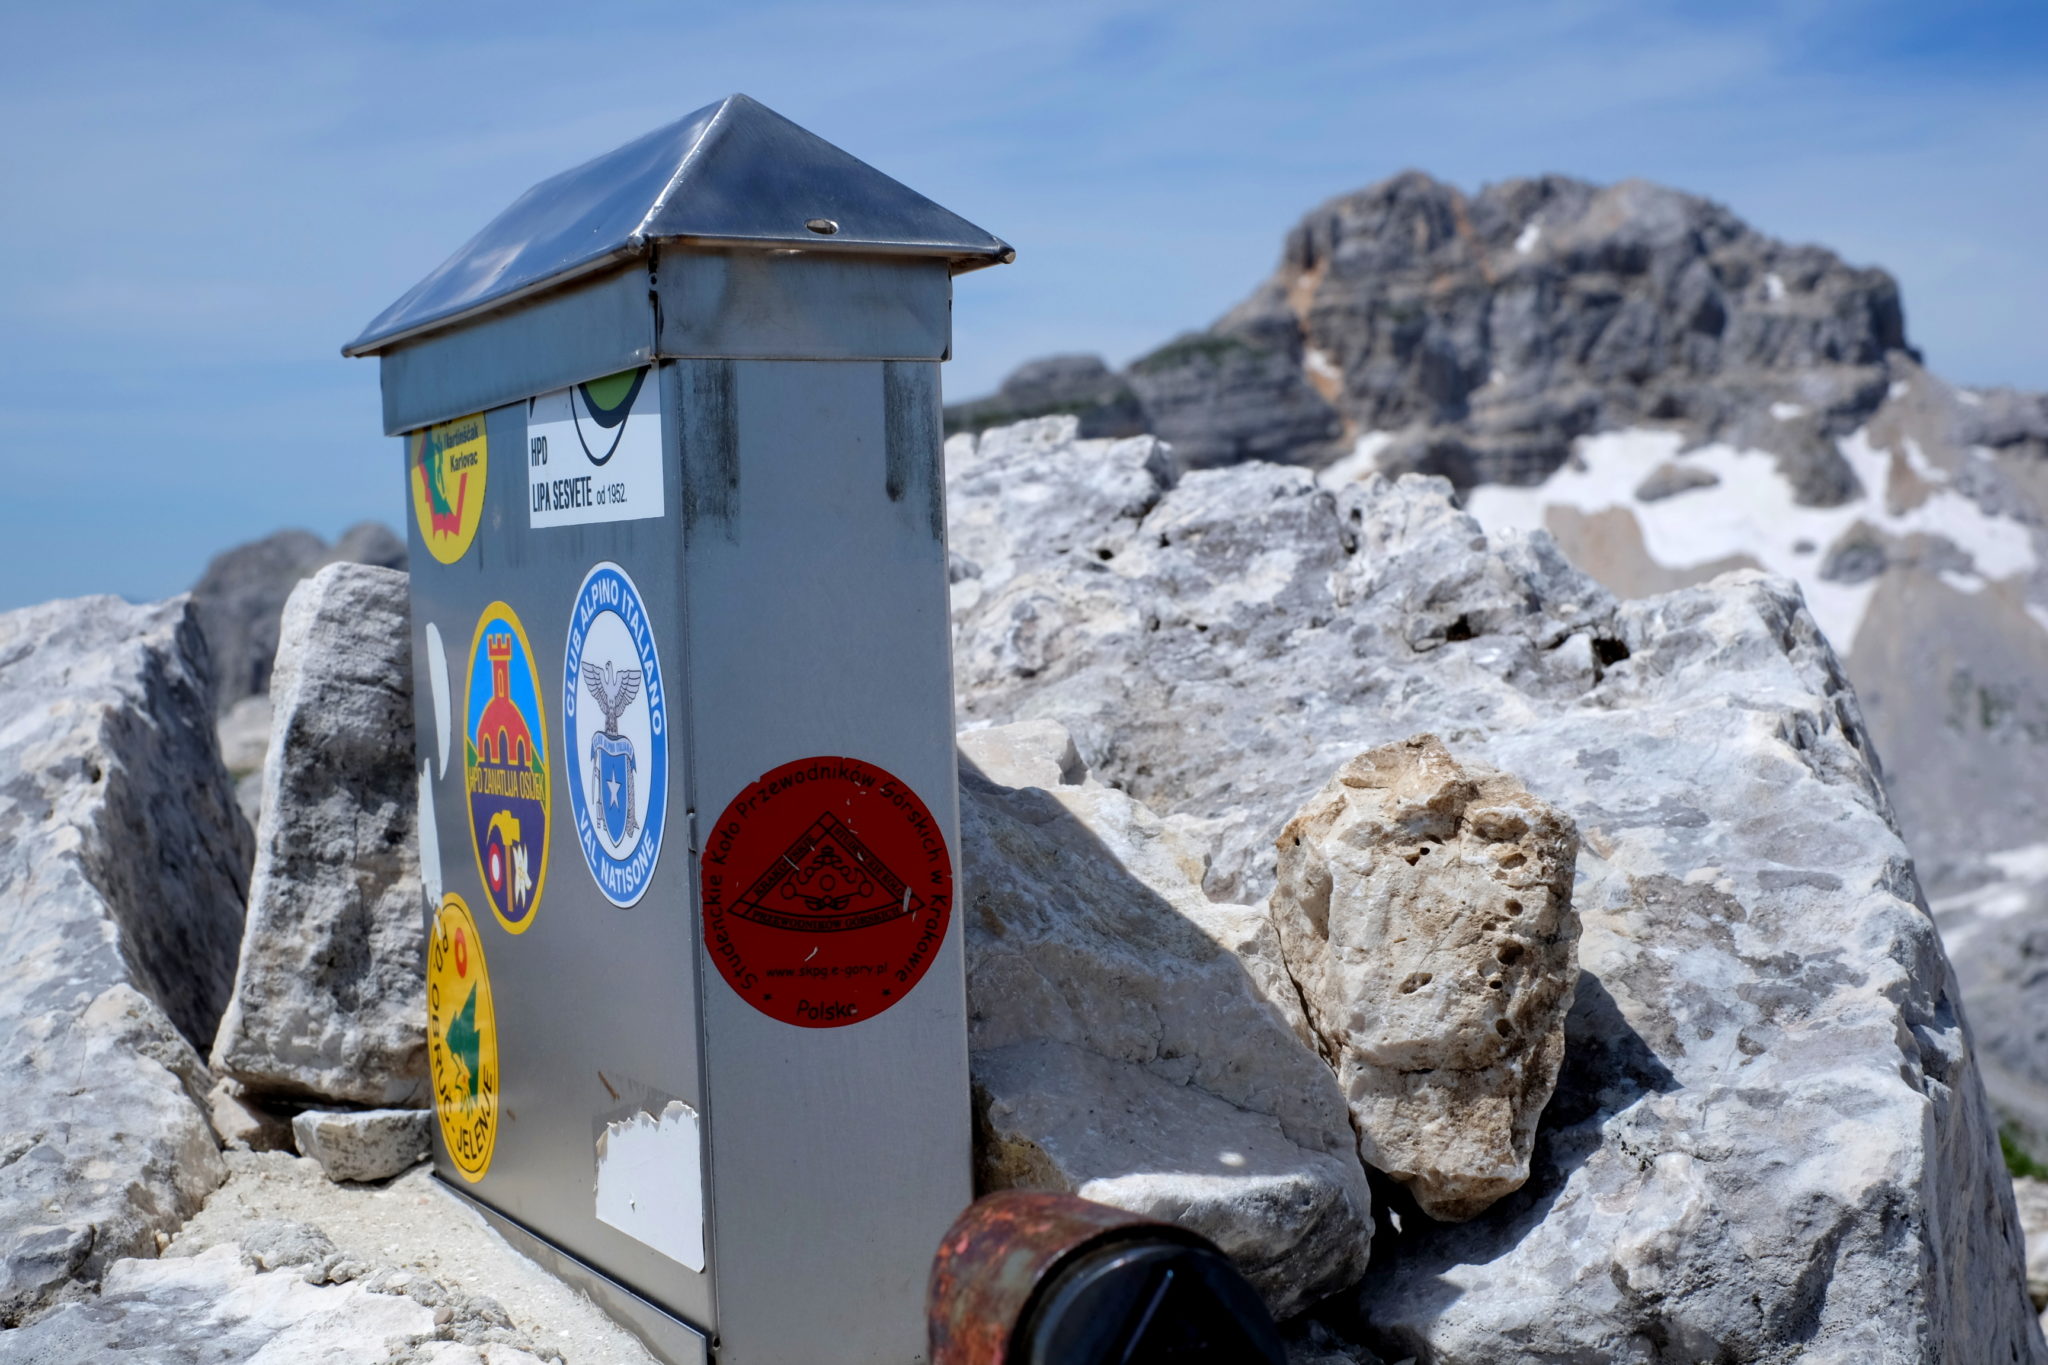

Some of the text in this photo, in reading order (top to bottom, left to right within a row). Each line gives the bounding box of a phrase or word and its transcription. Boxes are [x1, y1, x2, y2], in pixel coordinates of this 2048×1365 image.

[450, 451, 478, 472] Karlovac
[531, 436, 547, 467] HPD
[532, 476, 627, 512] LIPA SESVETE od 1952.
[566, 577, 662, 735] CLUB ALPINO ITALIANO
[736, 764, 876, 818] Przewodników
[880, 780, 943, 862] Górskich
[580, 807, 654, 894] VAL NATISONE
[931, 871, 943, 884] w
[704, 875, 759, 990] Studenckie
[896, 894, 947, 982] Krakowie
[457, 1064, 493, 1160] JELENJE
